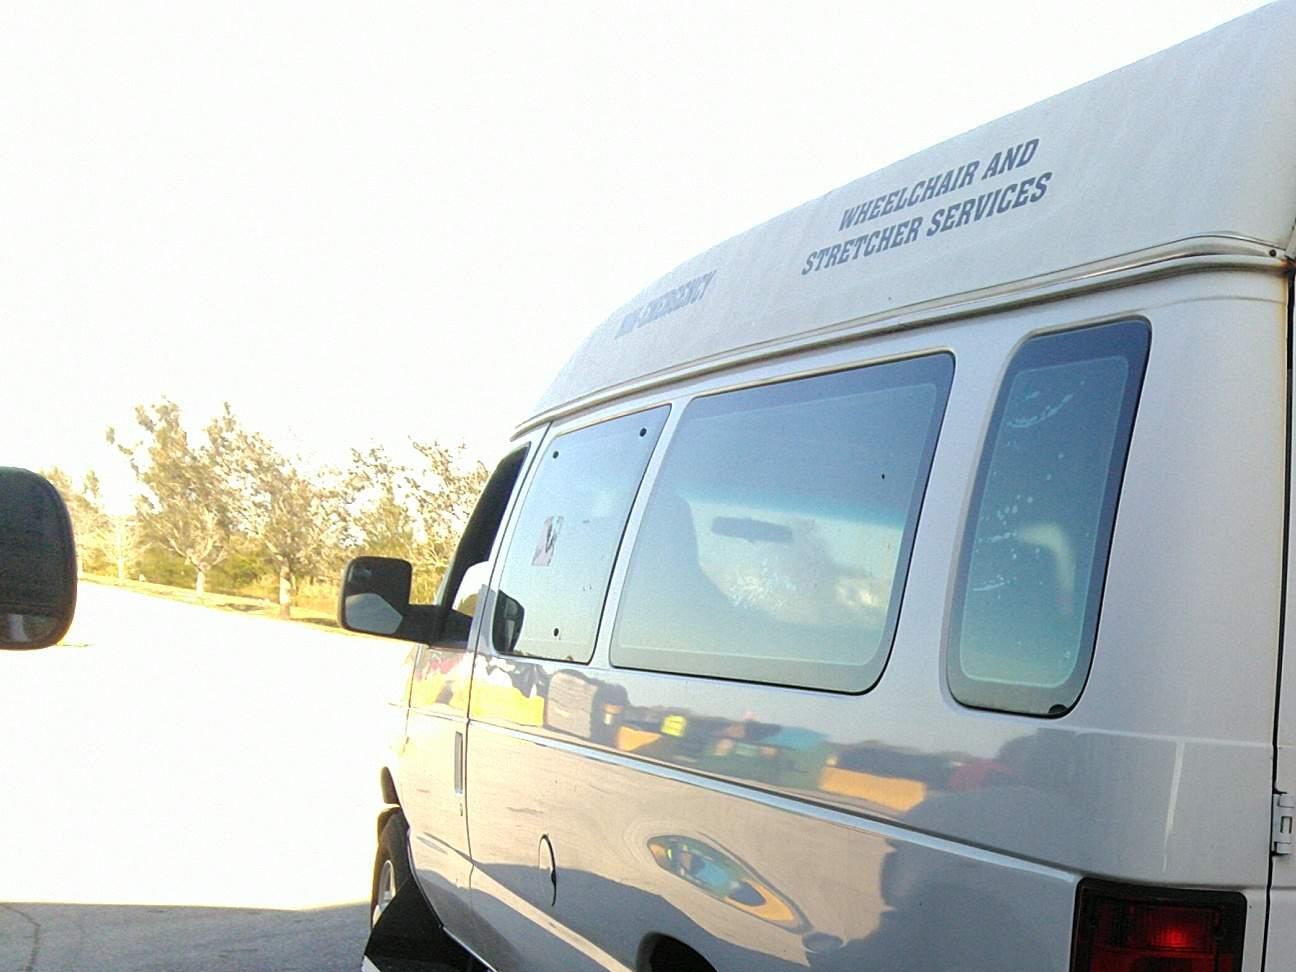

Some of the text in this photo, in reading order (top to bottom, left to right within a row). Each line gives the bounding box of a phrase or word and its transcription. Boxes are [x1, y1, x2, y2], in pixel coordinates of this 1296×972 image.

[801, 171, 1053, 276] STRETCHER SERVICES
[838, 138, 1040, 233] WHEELCHAIR AND
